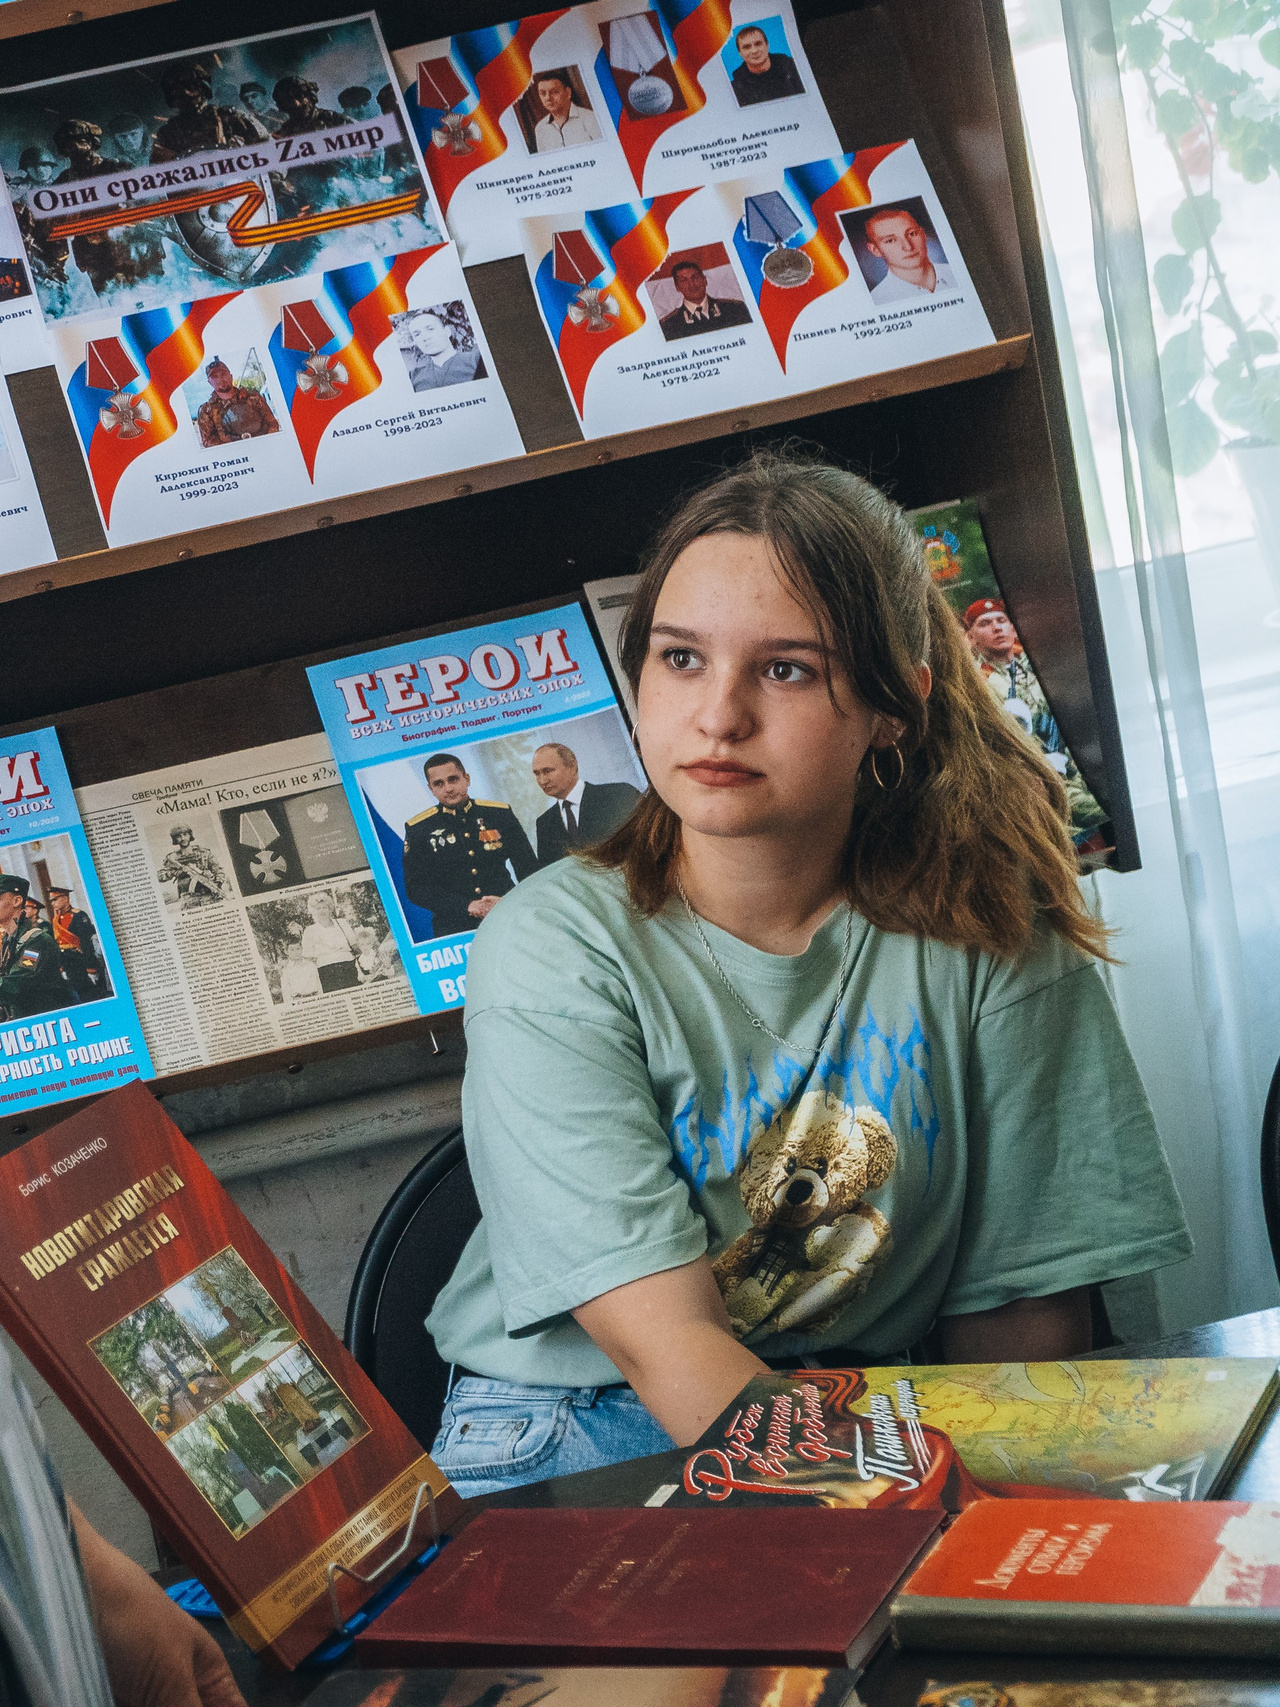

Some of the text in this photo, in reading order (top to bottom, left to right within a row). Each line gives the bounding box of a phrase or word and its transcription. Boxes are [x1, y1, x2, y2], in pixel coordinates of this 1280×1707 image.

[661, 122, 801, 159] Широколобов Александр
[700, 140, 769, 162] Викторович
[33, 124, 385, 212] Они сражались Za мир
[538, 159, 597, 178] Александр
[709, 151, 768, 171] 1987-2023
[506, 175, 573, 195] Николаевич
[839, 316, 877, 334] Артем
[879, 296, 965, 323] Владимирович
[853, 320, 913, 342] 1992-2023
[617, 337, 747, 374] Заздравный Анатолий
[642, 355, 730, 381] Александрович
[331, 396, 487, 439] Азадов Сергей Витальевич
[383, 417, 443, 439] 1998-2023
[154, 456, 249, 483] Кирюхин Роман
[179, 481, 239, 501] 1999-2023
[334, 628, 579, 724] ГЕРОИ
[348, 673, 586, 740] ВСЕХ ИСТОРИЧЕСКИХ ЭПОХ
[401, 703, 543, 743] Биография. Подвиг. Портрет
[131, 778, 204, 802] СВЕЧА ПАМЯТИ
[155, 766, 337, 817] «Мама! Кто, если не я?»
[7, 797, 55, 821] ЭПОХ
[66, 1036, 135, 1068] РОДИНЕ
[50, 1136, 109, 1178] КОЗАЧЕНКО
[19, 1163, 185, 1281] НОВОТИТАРОВСКАЯ
[75, 1211, 180, 1293] СРАЖАЕТСЯ
[357, 1508, 380, 1530] СТАНИЦЕ
[342, 1533, 373, 1562] ДЕЙСТВИЯМИ
[370, 1527, 380, 1538] ПО
[377, 1512, 397, 1532] ЗАЩИТЕ
